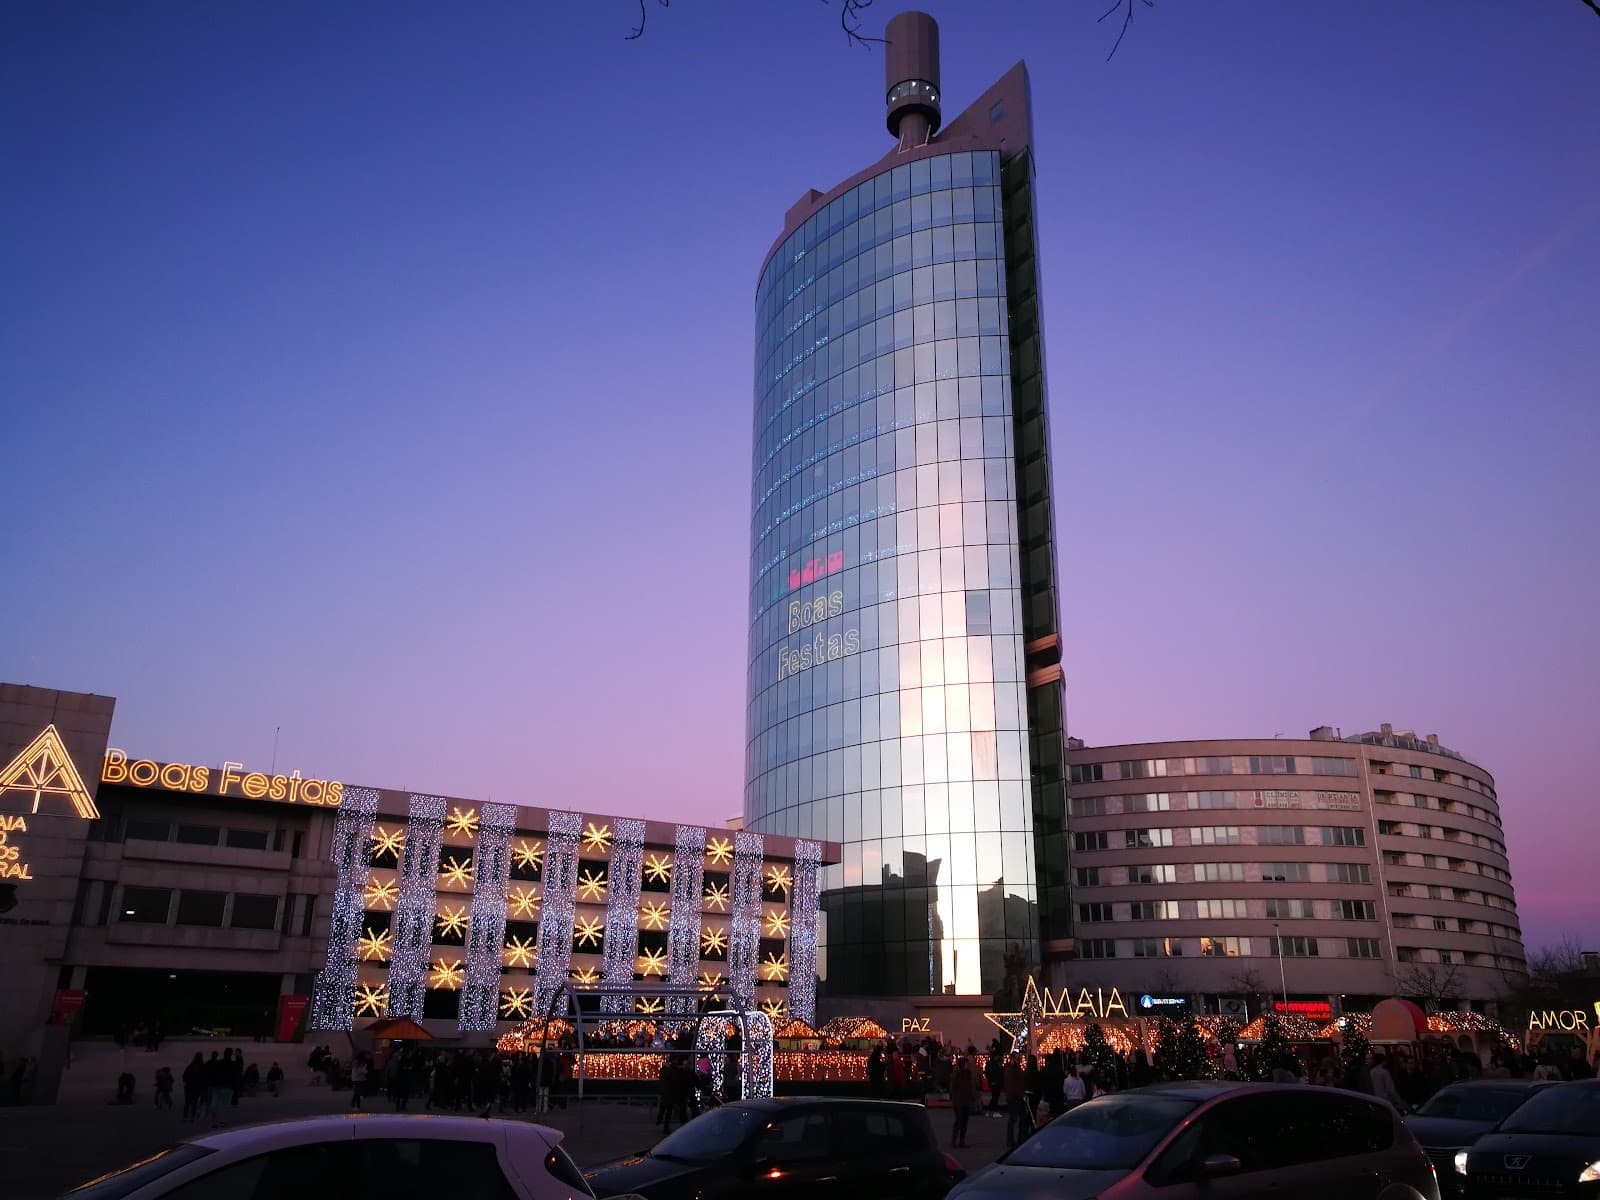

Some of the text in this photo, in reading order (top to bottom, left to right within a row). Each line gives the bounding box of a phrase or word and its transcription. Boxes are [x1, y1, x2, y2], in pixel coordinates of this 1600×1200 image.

[788, 590, 843, 635] Boas
[777, 628, 860, 682] Festas
[102, 748, 344, 806] Boas Festas
[1042, 987, 1129, 1019] MAIA
[1529, 1010, 1590, 1031] AMOR
[902, 1017, 931, 1033] PAZ
